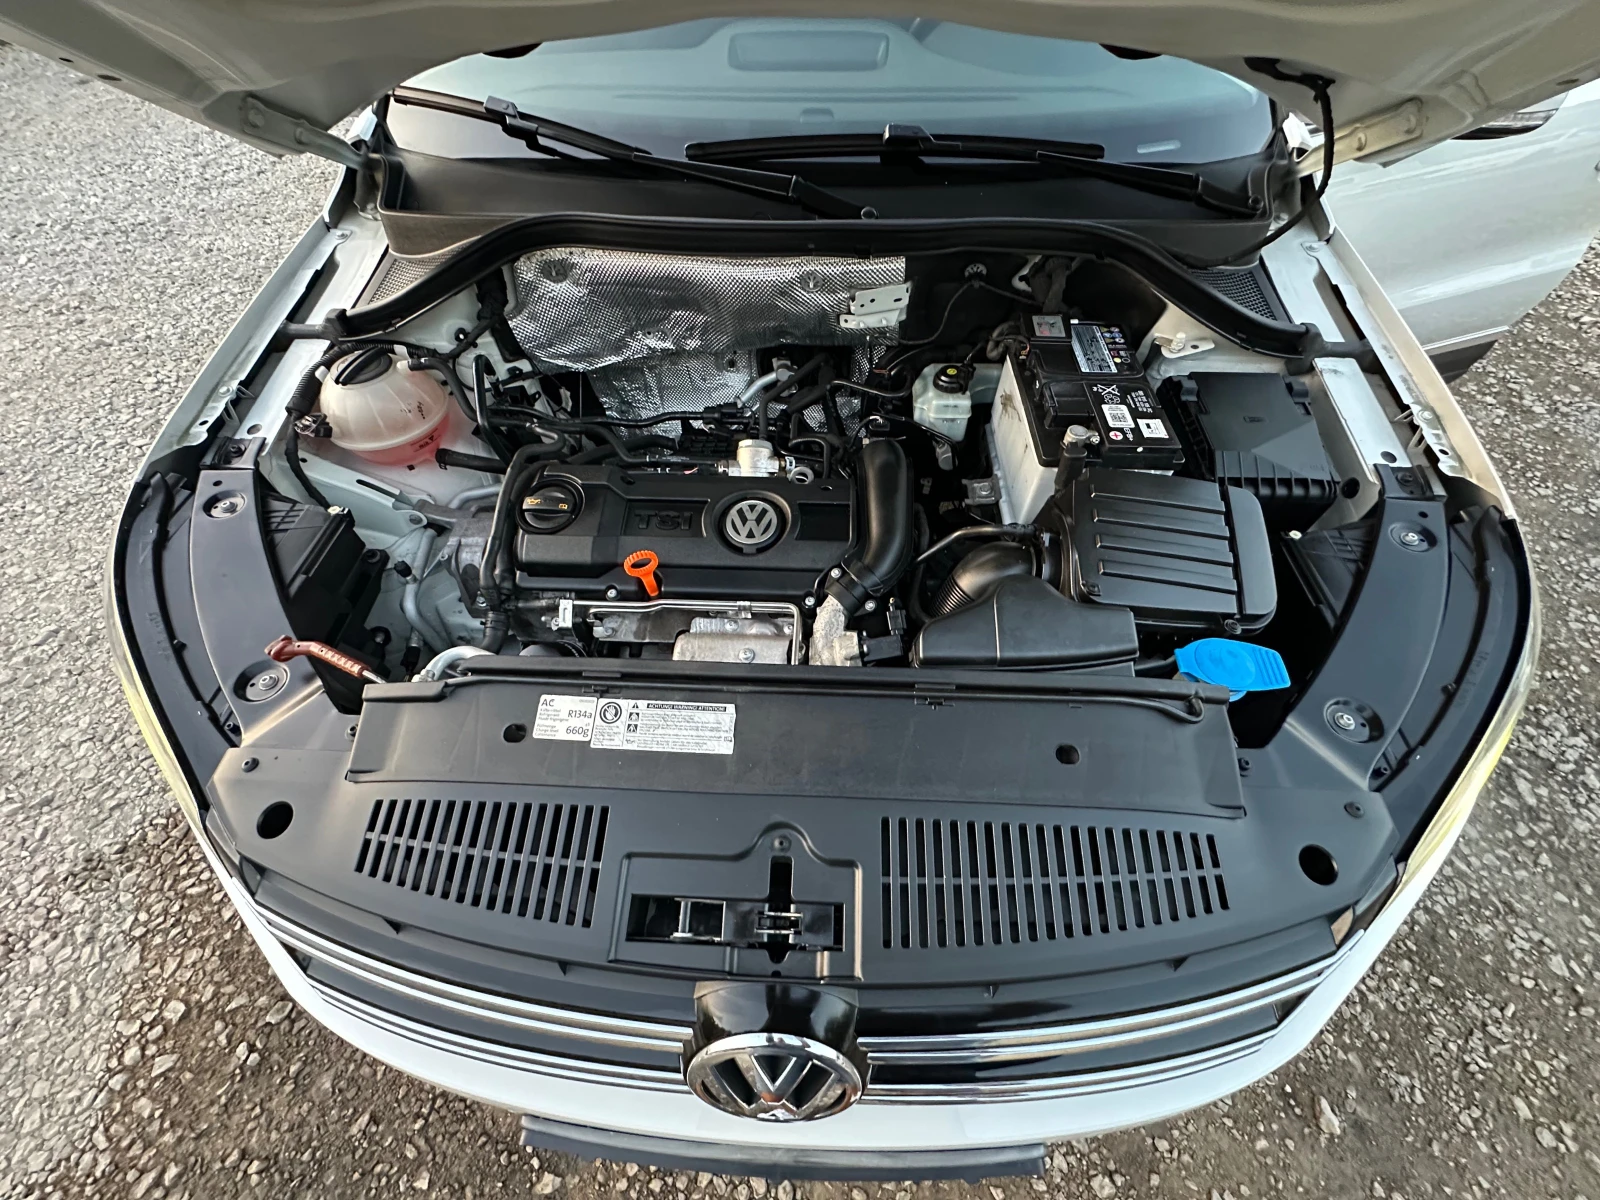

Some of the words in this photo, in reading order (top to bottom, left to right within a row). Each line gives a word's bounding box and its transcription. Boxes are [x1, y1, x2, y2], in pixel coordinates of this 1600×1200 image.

[634, 510, 693, 531] TSI
[541, 698, 555, 707] AC
[567, 709, 593, 719] R134a
[565, 725, 590, 738] 660g
